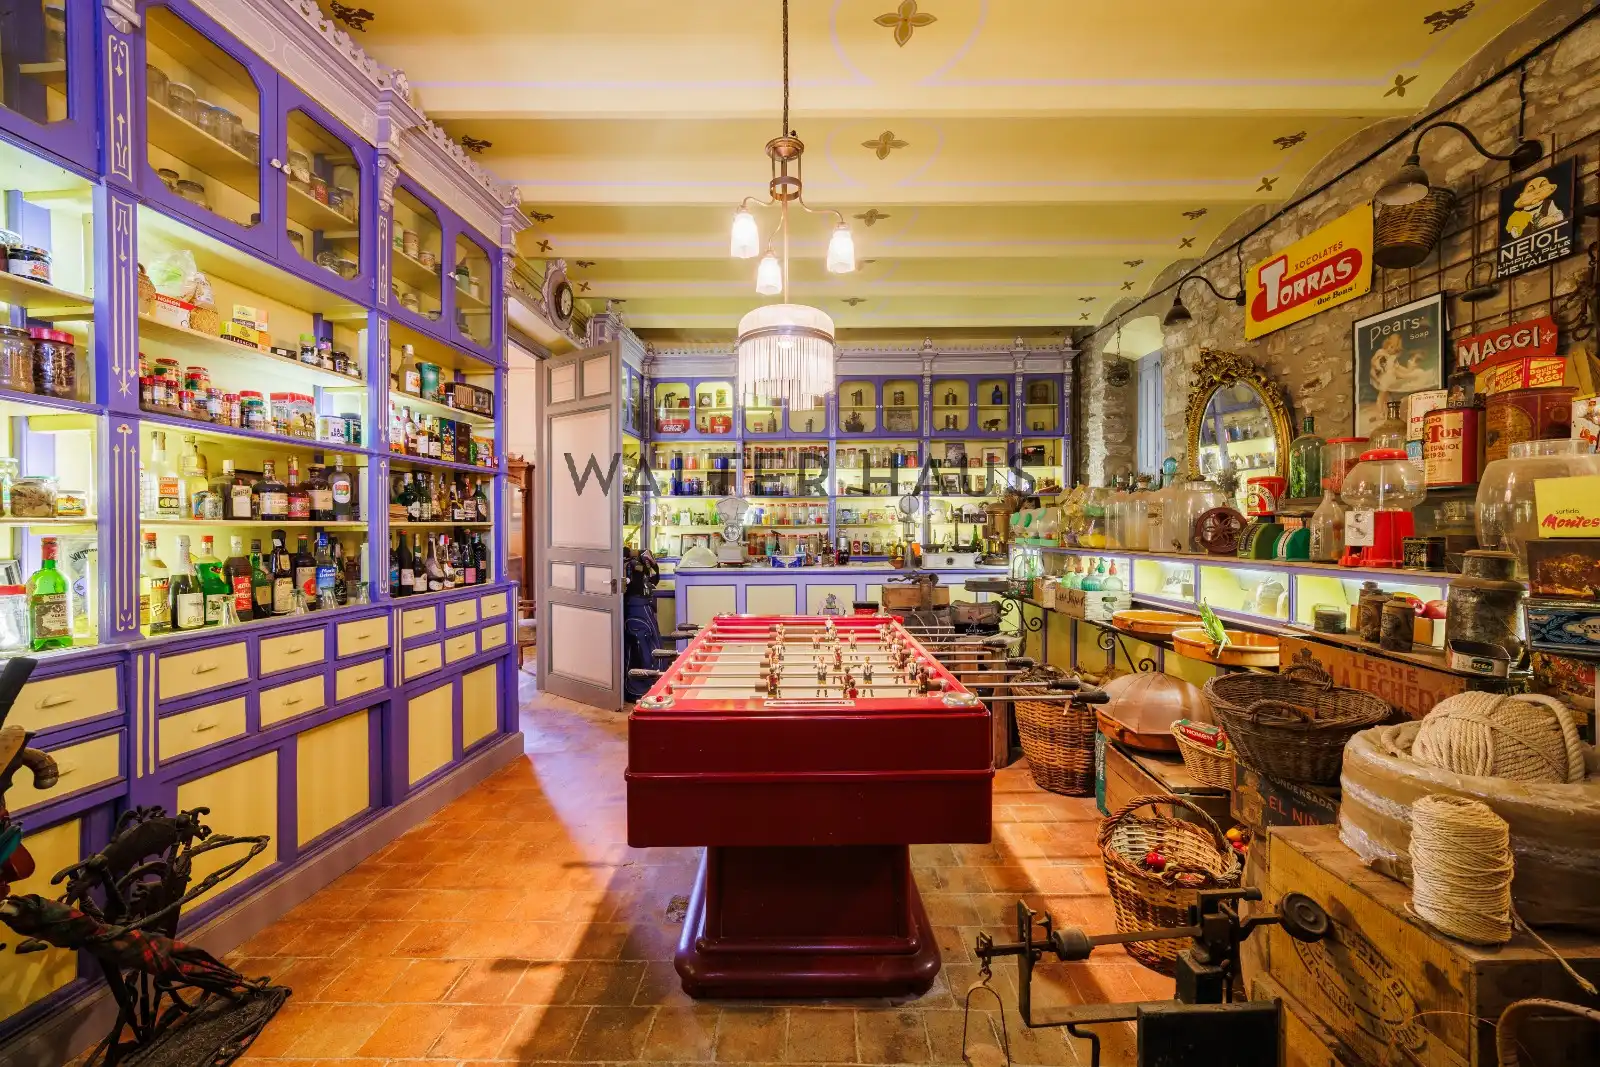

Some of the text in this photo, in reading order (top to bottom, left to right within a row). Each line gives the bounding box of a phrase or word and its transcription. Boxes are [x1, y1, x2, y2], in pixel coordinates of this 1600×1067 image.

[1294, 241, 1344, 271] XOCOLATES
[1501, 226, 1569, 263] NETOL
[1497, 248, 1571, 278] METALES
[1498, 254, 1534, 270] LIMPIA
[1260, 256, 1353, 313] TORRAS
[1458, 325, 1540, 367] MAGGI
[1530, 372, 1563, 385] MAGGI
[1351, 656, 1419, 684] LECHE
[1268, 795, 1287, 816] EL
